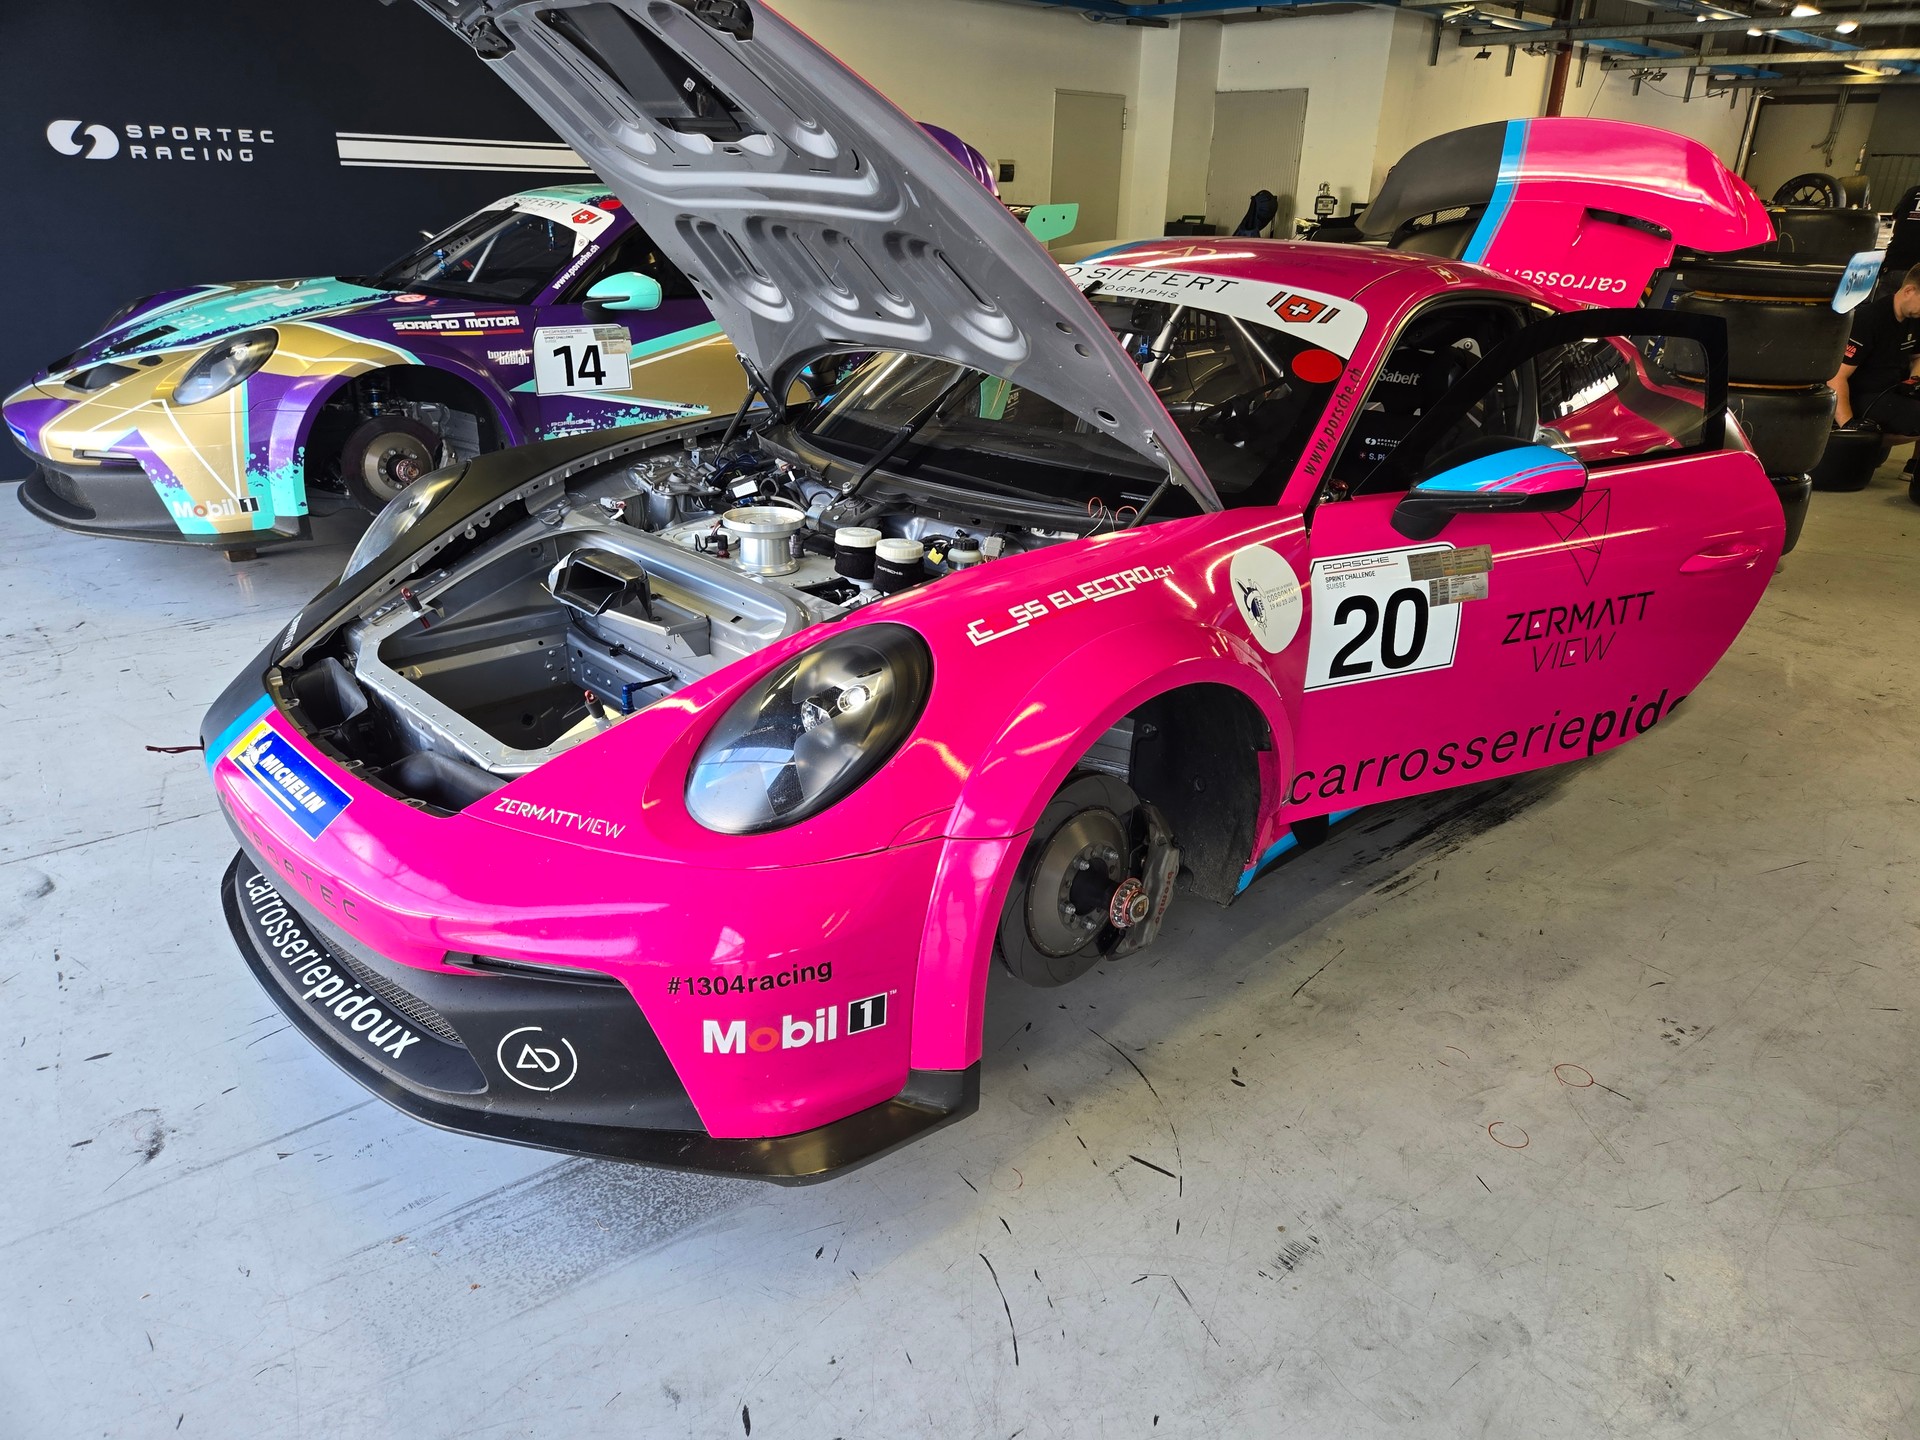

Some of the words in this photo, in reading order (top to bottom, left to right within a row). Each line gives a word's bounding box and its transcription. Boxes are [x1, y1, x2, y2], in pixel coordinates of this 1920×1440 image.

[125, 124, 275, 143] SPORTEC
[129, 145, 254, 162] RACING
[552, 243, 600, 291] www.porsche.ch
[1086, 267, 1240, 293] SIFFERT
[392, 319, 460, 331] SORIANO
[464, 315, 520, 328] MOTORI
[553, 345, 606, 387] 14
[1378, 368, 1421, 386] Sabelt
[1302, 367, 1363, 477] www.porsche.ch
[171, 498, 235, 518] Mobil
[1322, 556, 1390, 571] PORSCHE
[1325, 574, 1345, 583] SPRINT
[1344, 570, 1376, 580] CHALLENGE
[1325, 581, 1346, 591] SUISSE
[1328, 587, 1429, 680] 20
[1501, 591, 1656, 645] ZERMATT
[1531, 631, 1617, 673] VIEW
[261, 750, 327, 814] MICHELIN
[494, 797, 626, 839] ZERMATTVIEW
[245, 873, 421, 1060] carrosseriepidoux
[667, 961, 833, 996] #1304racing
[702, 1005, 838, 1055] Mobil
